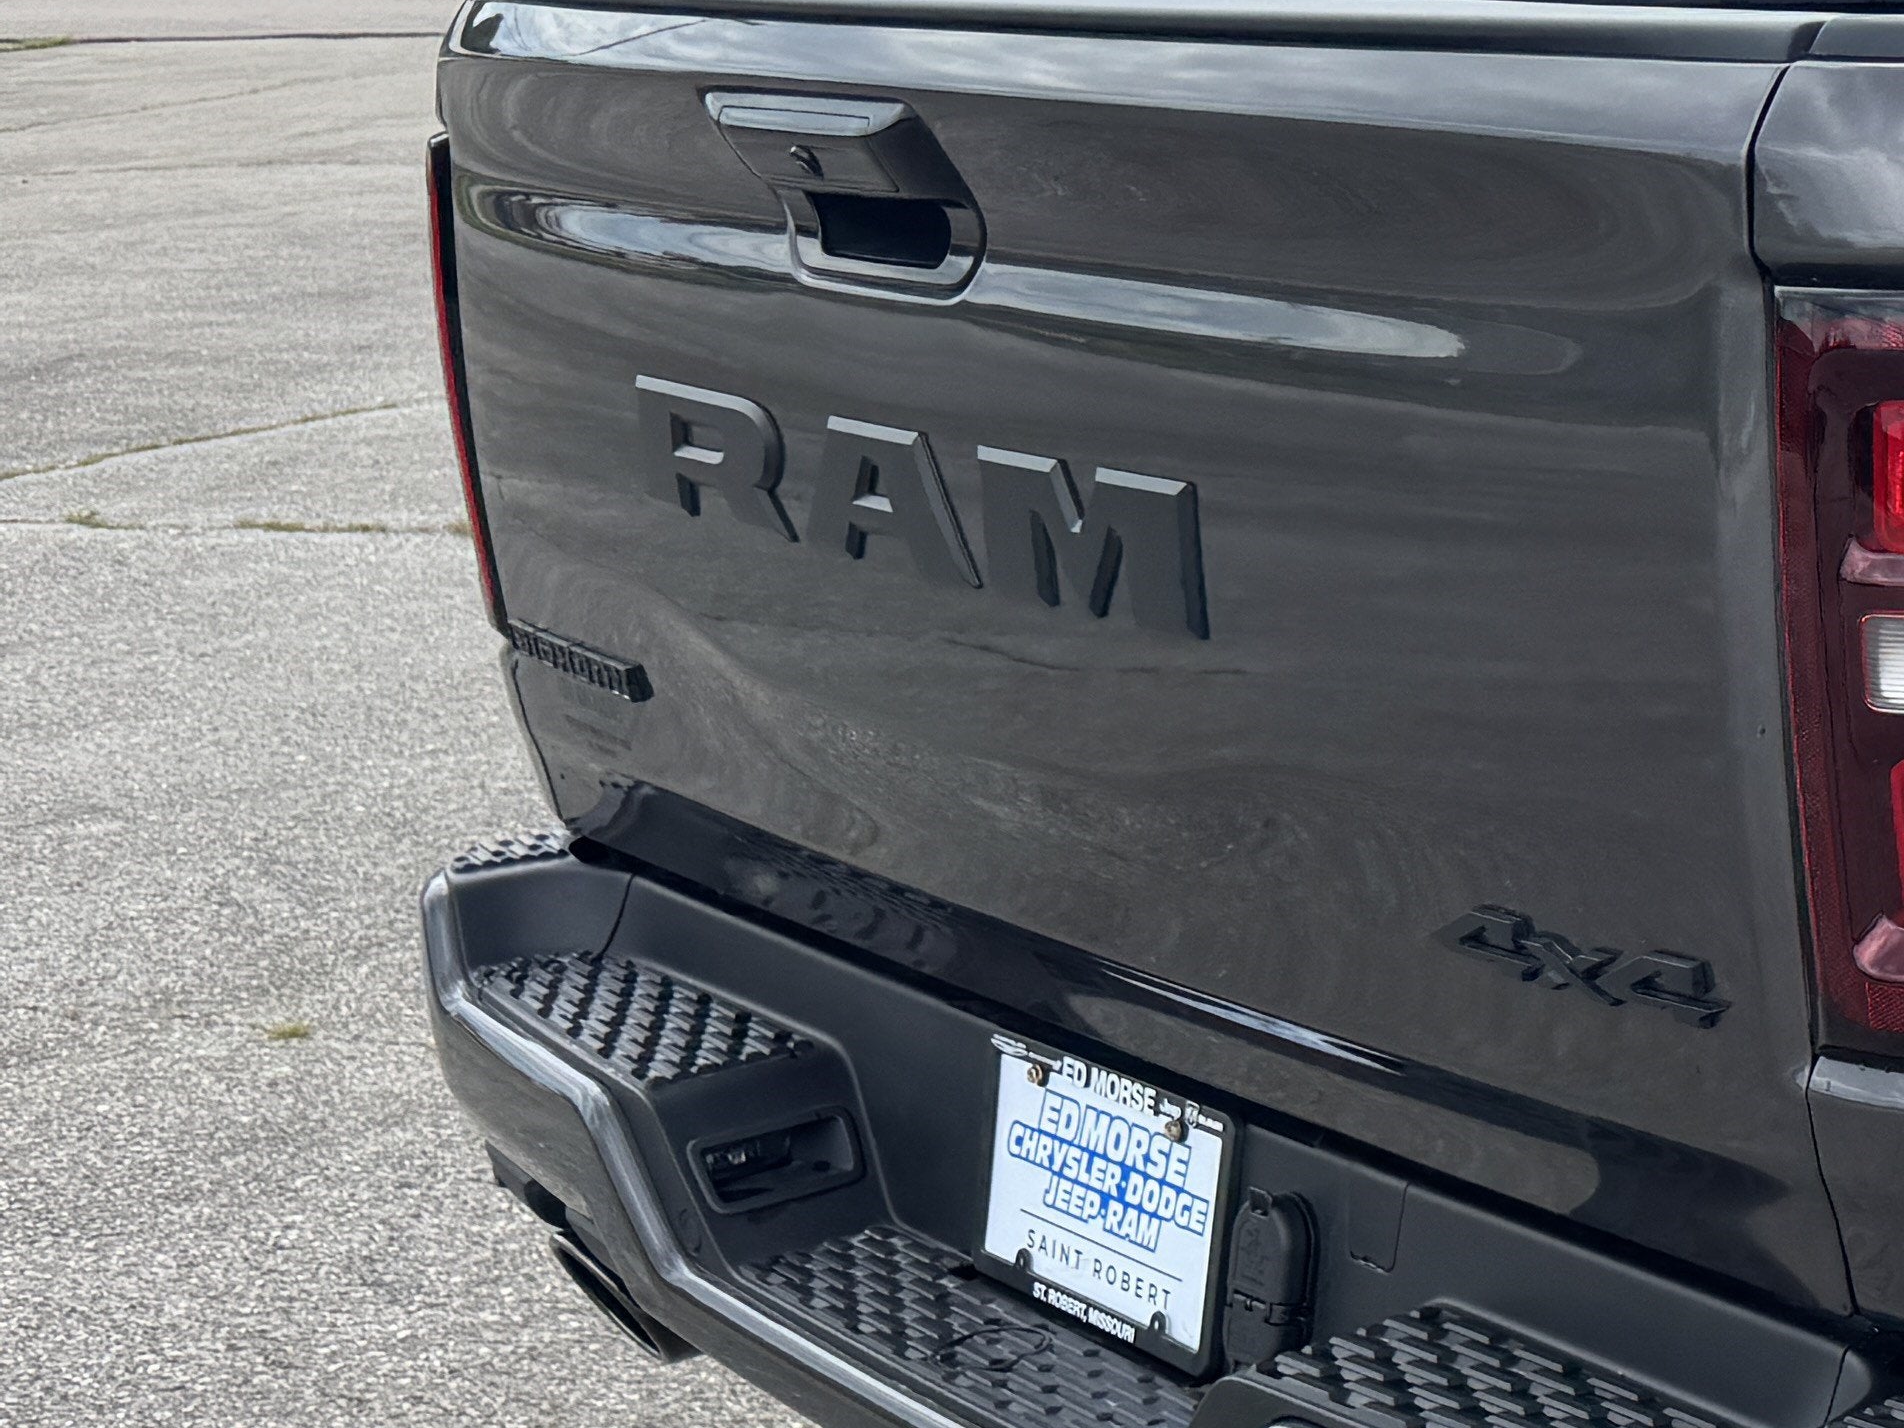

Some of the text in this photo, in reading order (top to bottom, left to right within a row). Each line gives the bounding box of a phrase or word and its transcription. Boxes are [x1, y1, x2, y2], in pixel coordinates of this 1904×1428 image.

[633, 374, 1210, 640] RAM
[1062, 1055, 1088, 1088] ED
[1091, 1066, 1158, 1115] MORSE
[1039, 1089, 1192, 1187] ED MORSE
[1026, 1229, 1172, 1312] SAINT ROBERT
